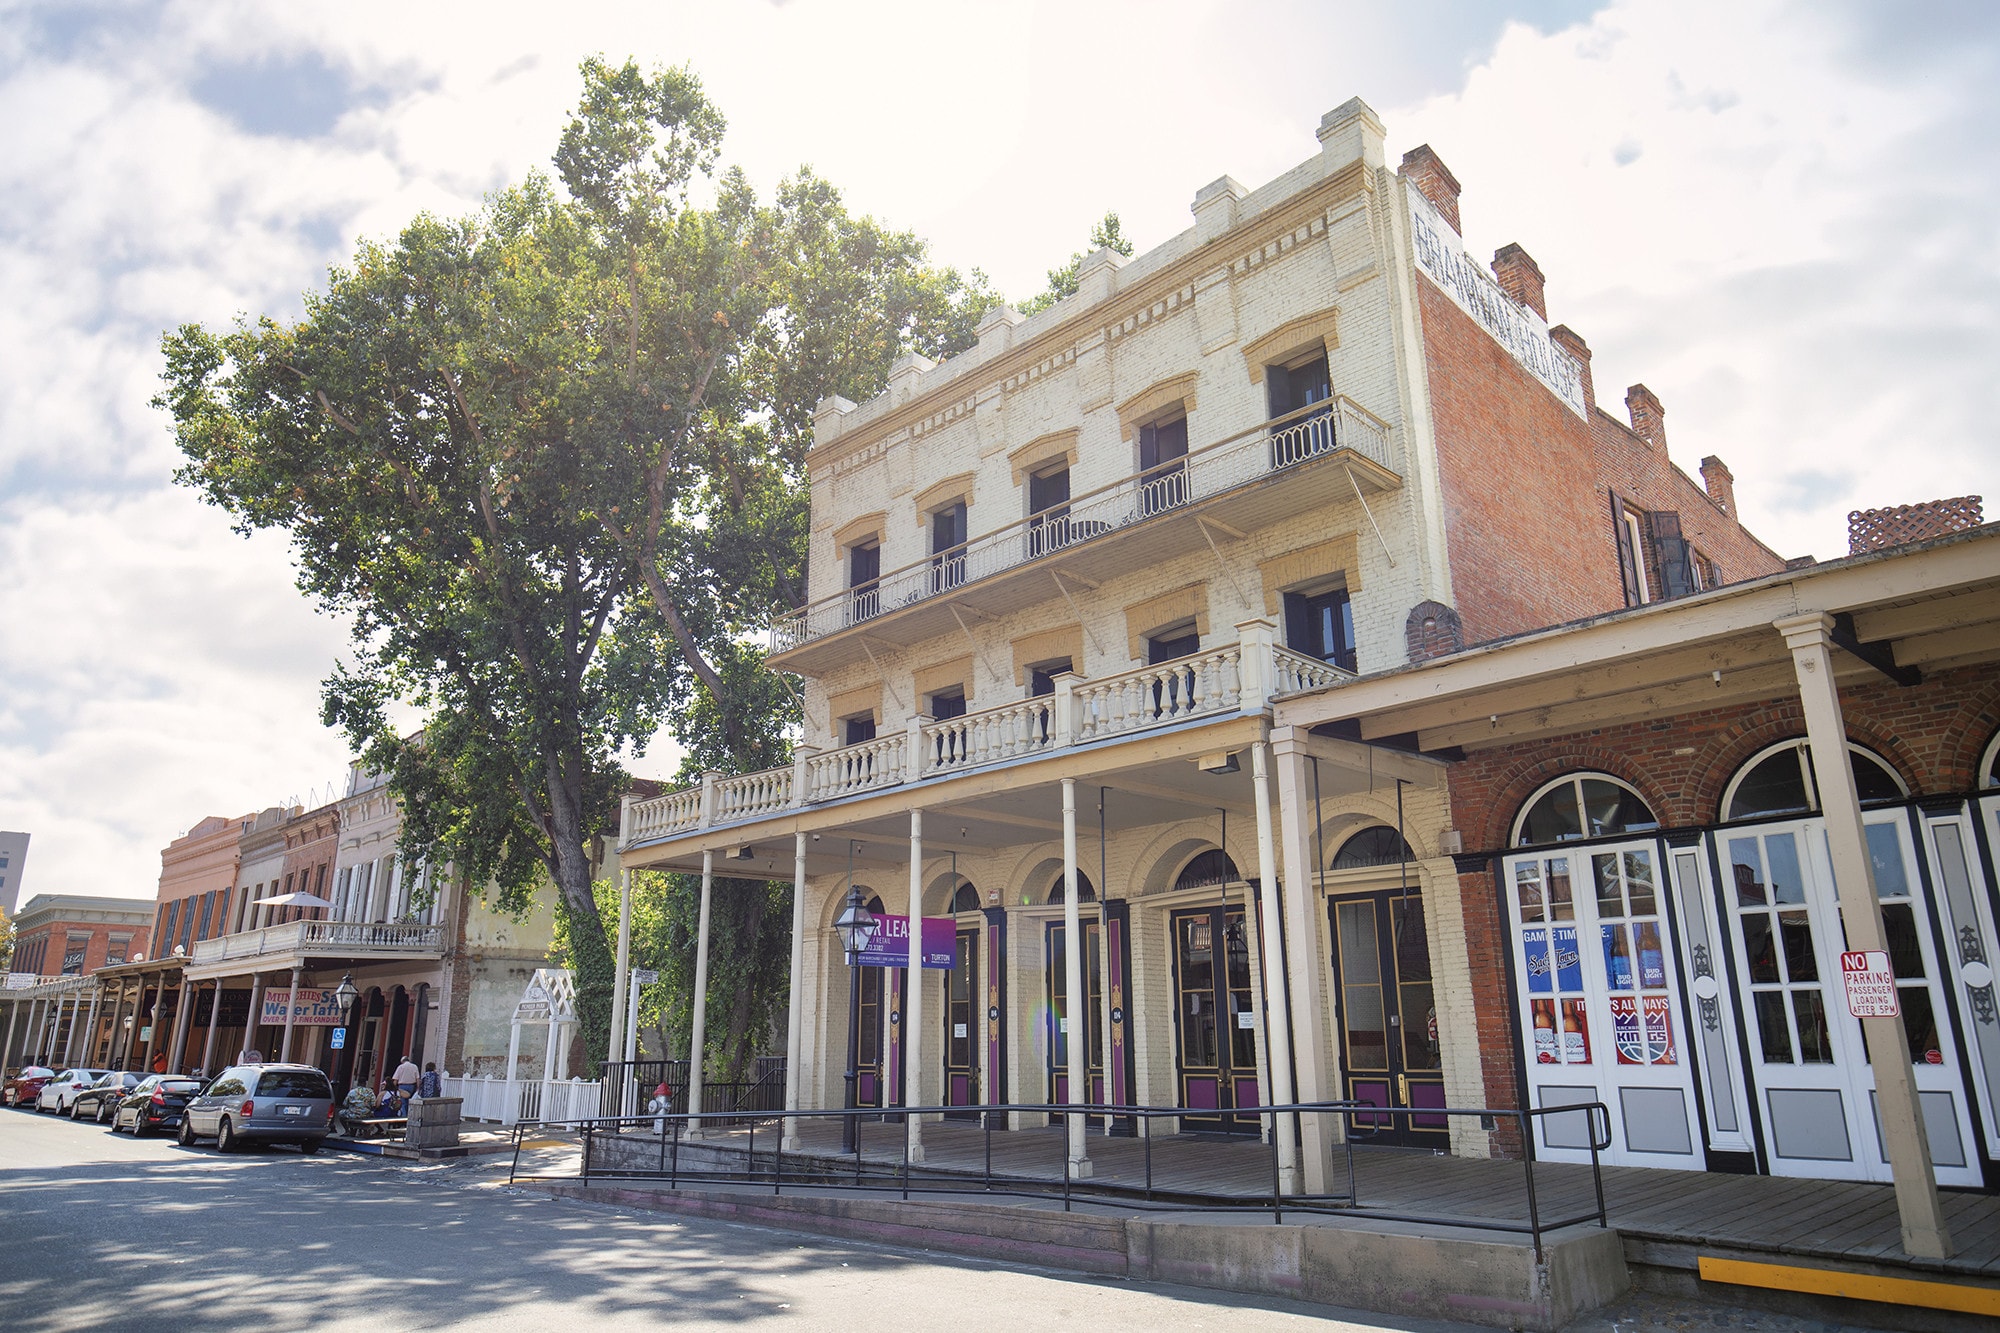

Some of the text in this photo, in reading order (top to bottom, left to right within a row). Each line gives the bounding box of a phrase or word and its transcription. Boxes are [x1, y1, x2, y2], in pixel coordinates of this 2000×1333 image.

[1516, 316, 1584, 412] HOUSE
[1843, 953, 1868, 971] NO
[1645, 967, 1661, 975] BUD
[1845, 971, 1891, 985] PARKING
[1848, 985, 1893, 995] PASSENGER
[1855, 996, 1889, 1005] LOADING
[265, 1003, 342, 1016] Waer Taff
[1853, 1005, 1896, 1015] AFTER 5PM
[262, 1016, 280, 1024] OVER
[313, 1016, 339, 1024] CANDIES
[1616, 1031, 1667, 1042] KINGS
